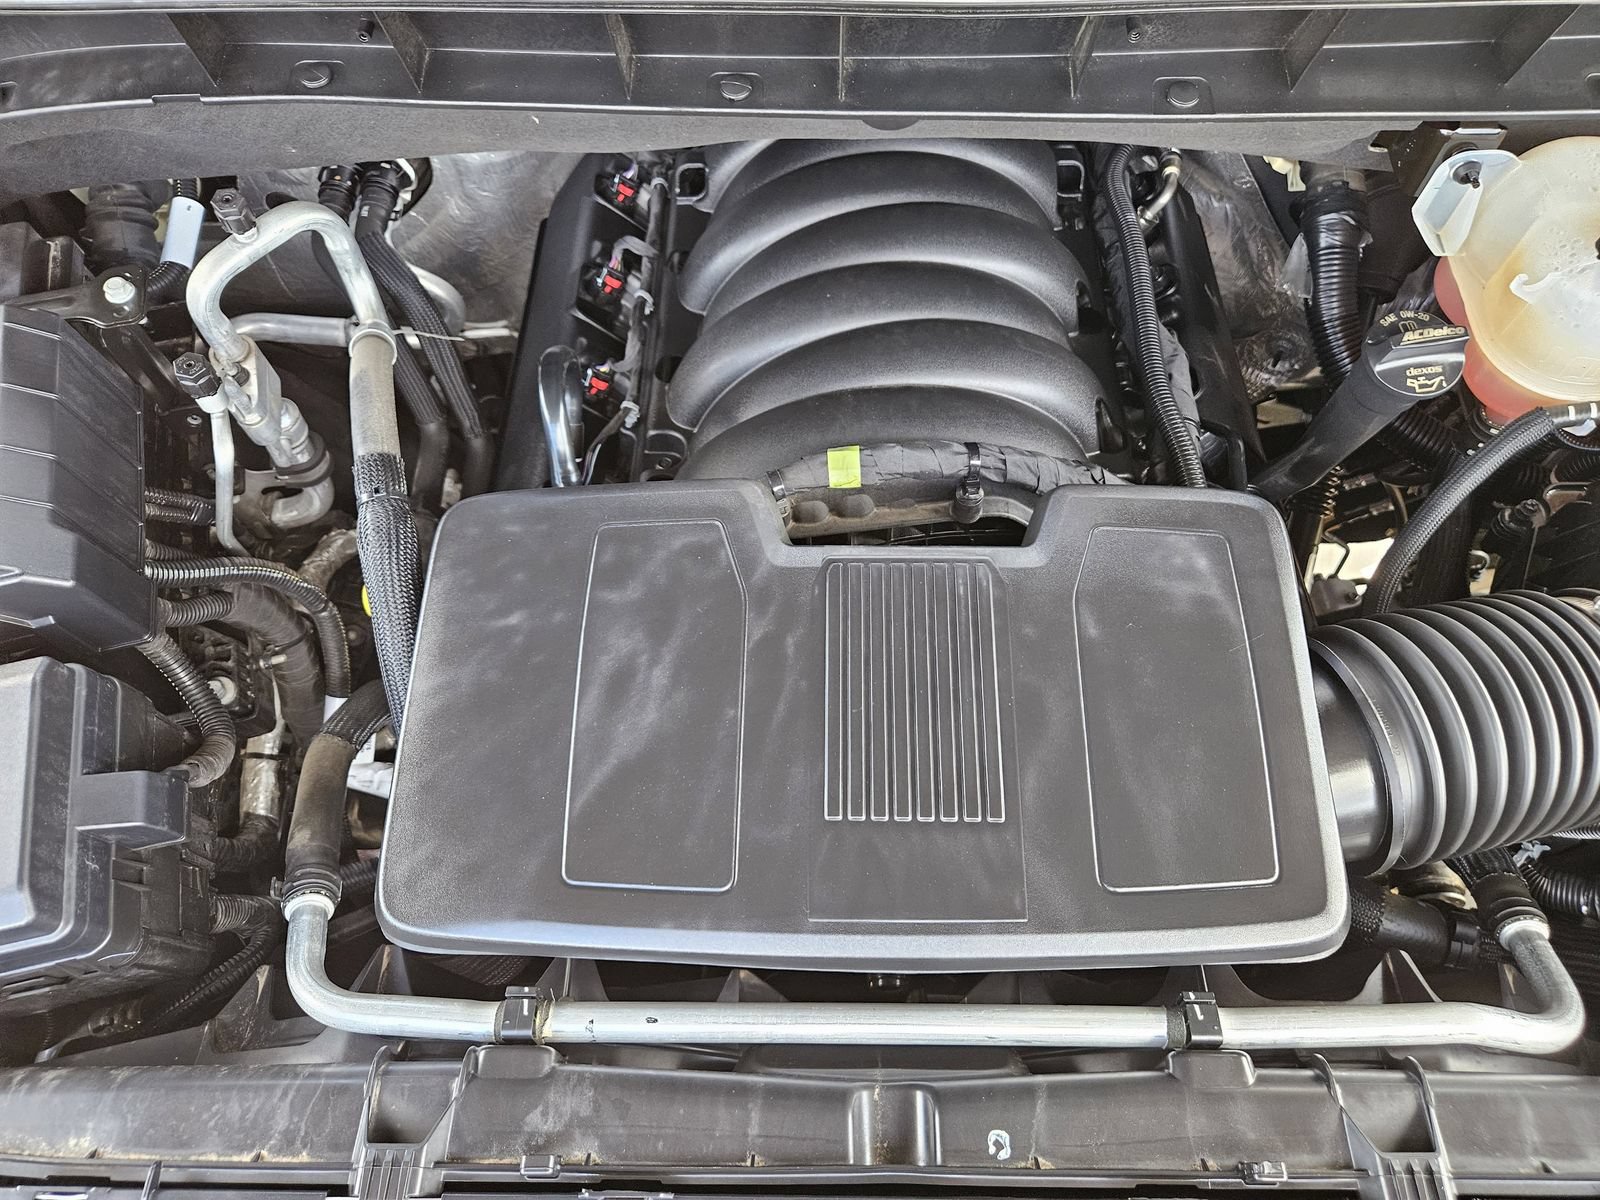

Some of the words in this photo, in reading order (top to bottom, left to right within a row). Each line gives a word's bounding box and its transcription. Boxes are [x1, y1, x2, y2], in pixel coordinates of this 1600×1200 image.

[1380, 313, 1398, 327] SAE
[1400, 310, 1430, 321] 0W-20
[1401, 326, 1465, 342] ACDelco
[1406, 365, 1443, 376] dexos
